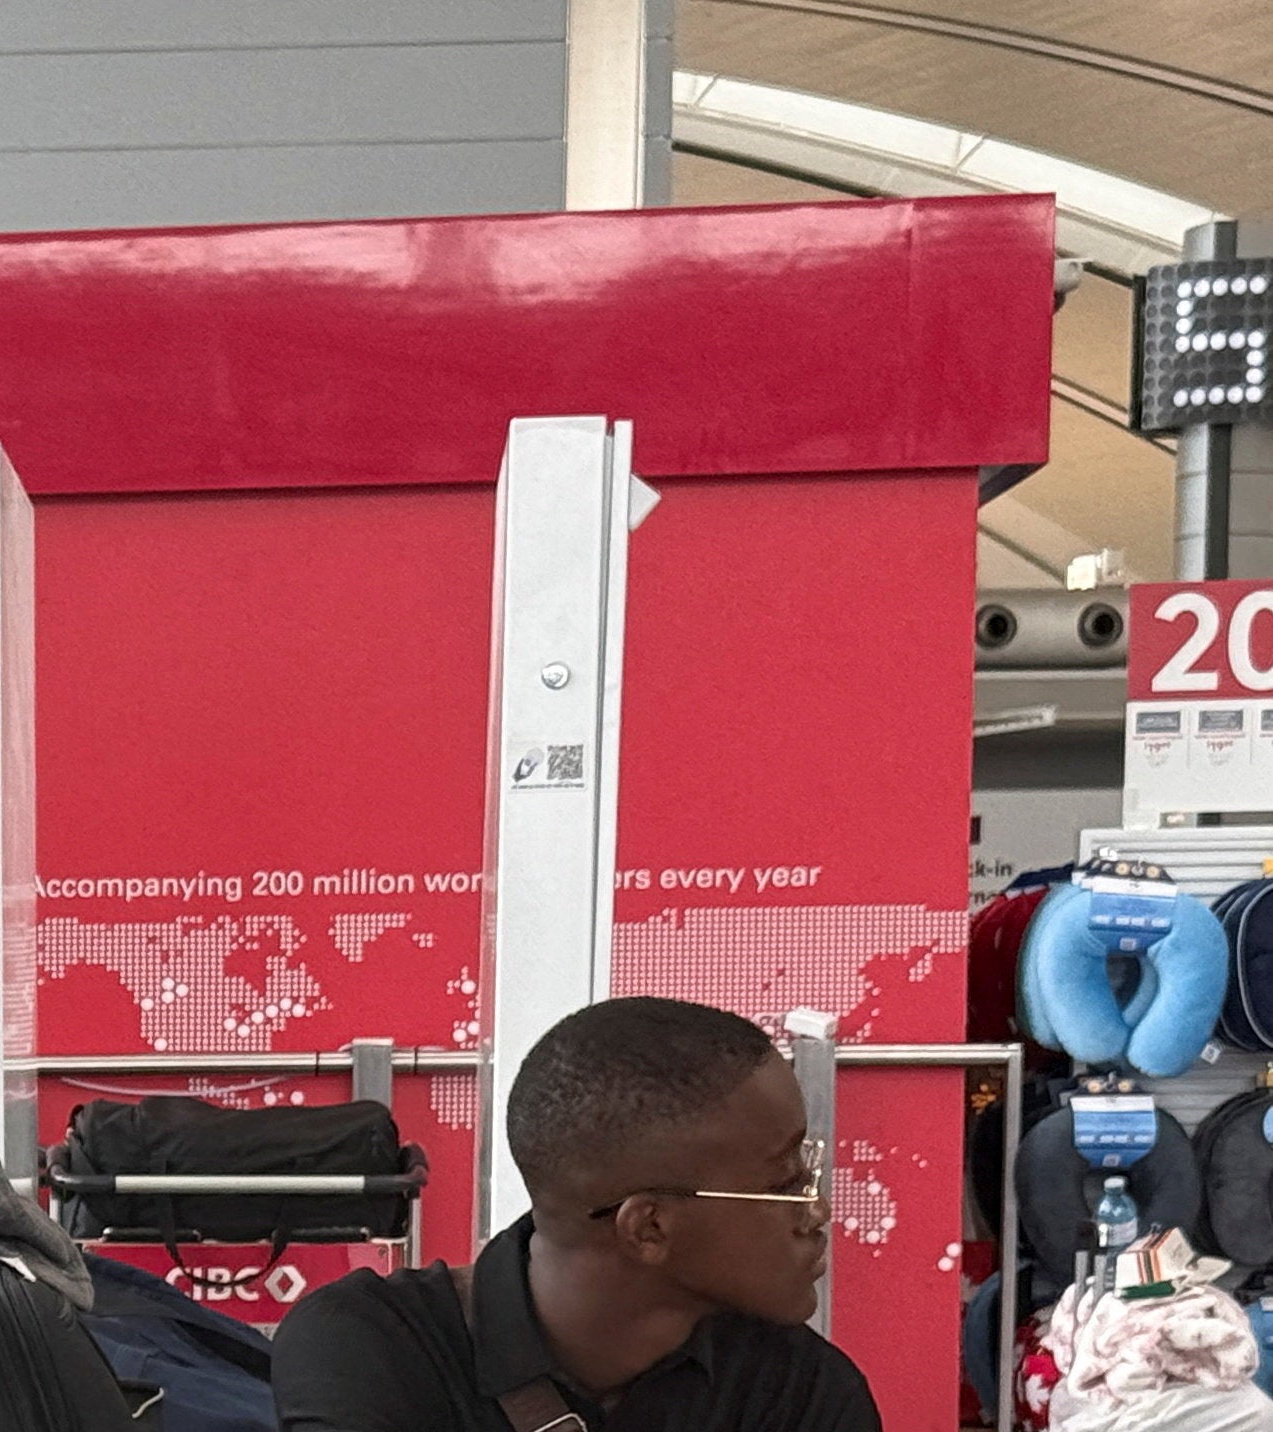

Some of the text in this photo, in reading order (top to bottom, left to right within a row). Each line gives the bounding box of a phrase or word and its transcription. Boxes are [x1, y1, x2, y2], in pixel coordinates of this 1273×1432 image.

[253, 872, 304, 896] 200
[312, 869, 413, 895] million
[423, 872, 483, 894] wor
[659, 868, 745, 894] every
[753, 865, 823, 894] year
[164, 1266, 260, 1301] CIBC
